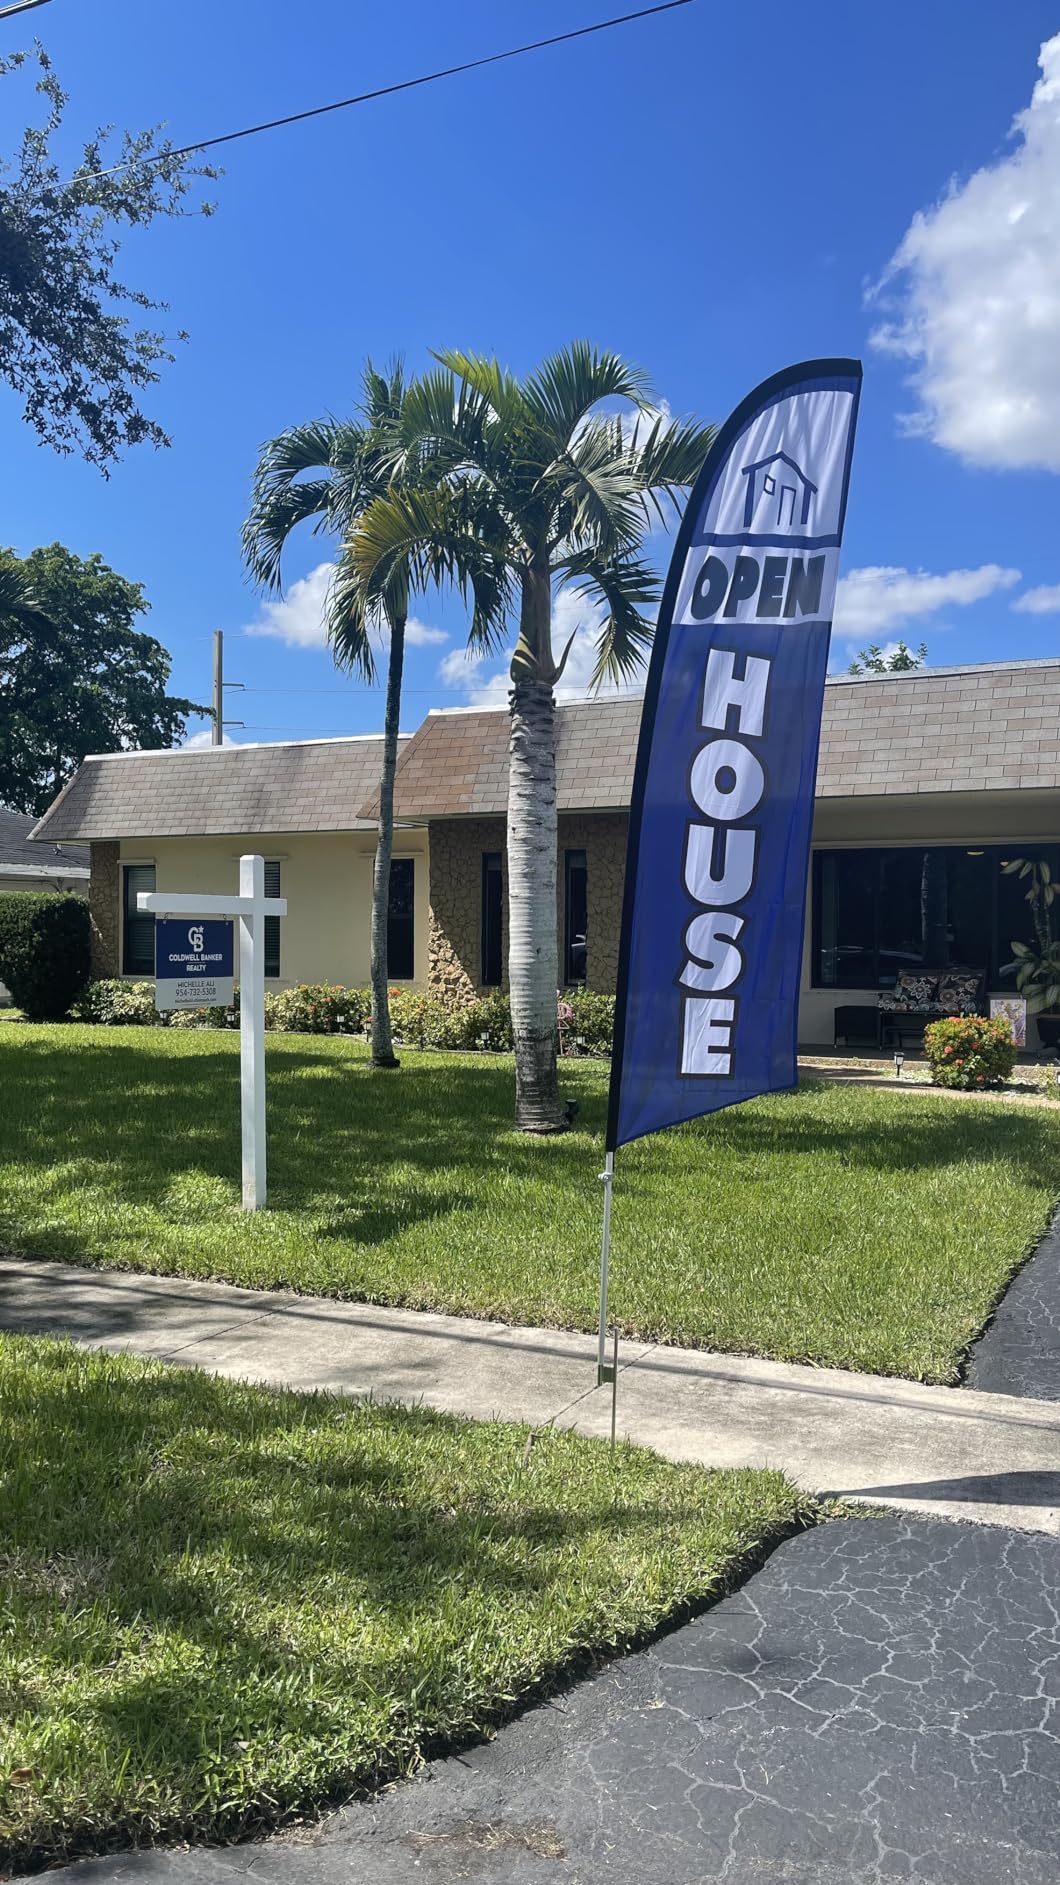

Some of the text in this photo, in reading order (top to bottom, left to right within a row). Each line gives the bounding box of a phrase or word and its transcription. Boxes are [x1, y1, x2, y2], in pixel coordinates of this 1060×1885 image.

[691, 555, 826, 620] OPEN
[680, 648, 771, 1075] HOUSE
[168, 954, 200, 962] COLDWELL
[176, 988, 216, 996] 954-732-5308
